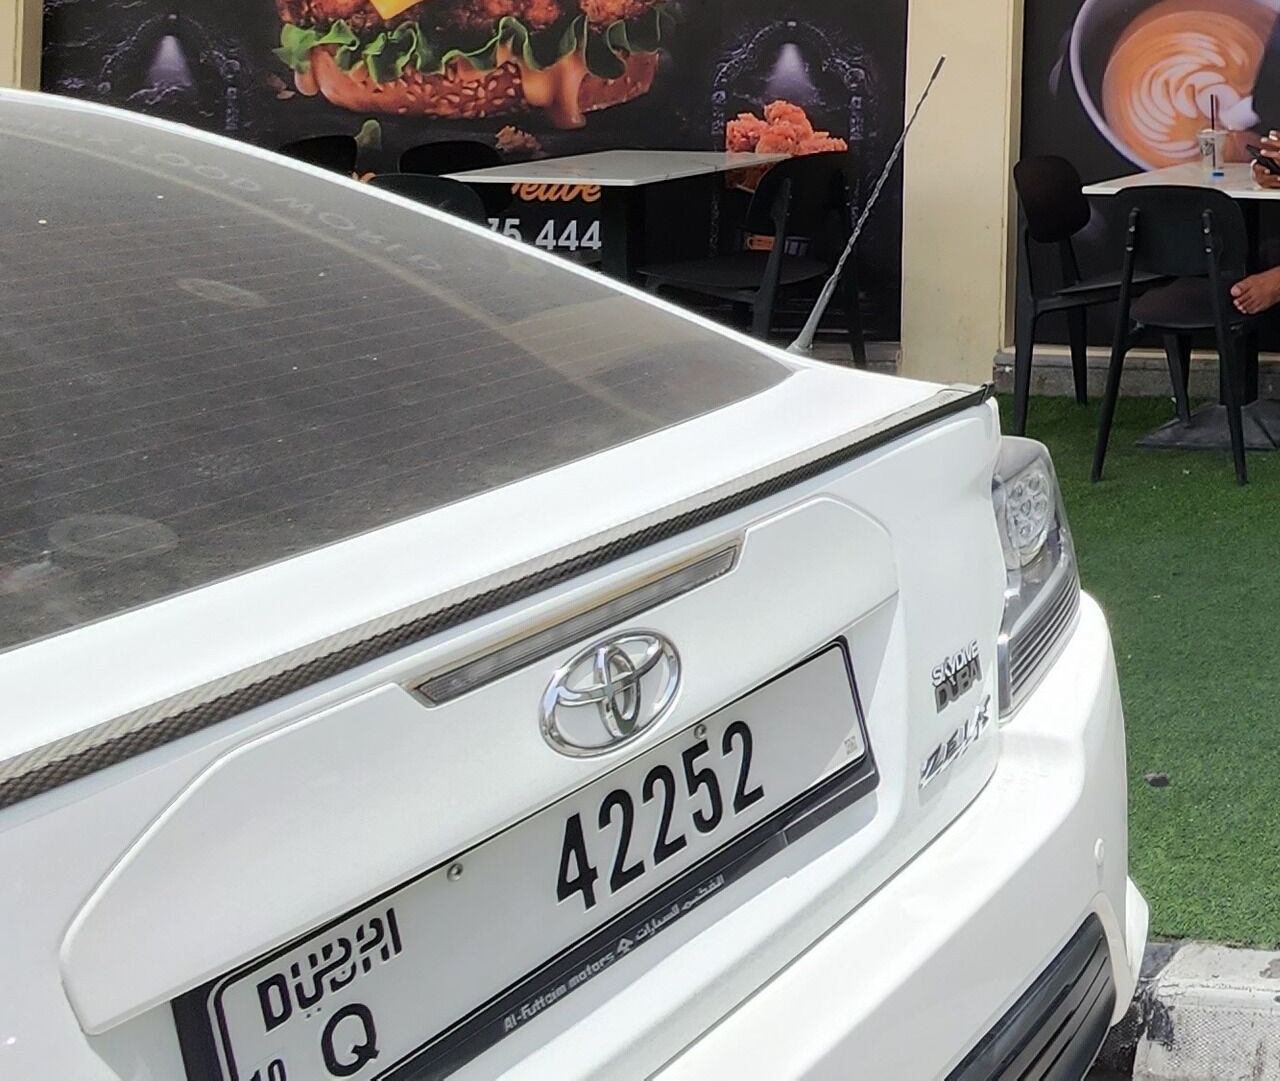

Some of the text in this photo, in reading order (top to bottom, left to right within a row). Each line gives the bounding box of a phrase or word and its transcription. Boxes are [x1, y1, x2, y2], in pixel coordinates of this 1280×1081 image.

[535, 218, 602, 251] 444
[931, 639, 980, 687] SKYDIVE
[934, 655, 983, 714] DUBAI
[556, 720, 765, 911] 42252
[503, 950, 615, 1033] Al-Futtaim motors
[320, 1002, 380, 1077] Q
